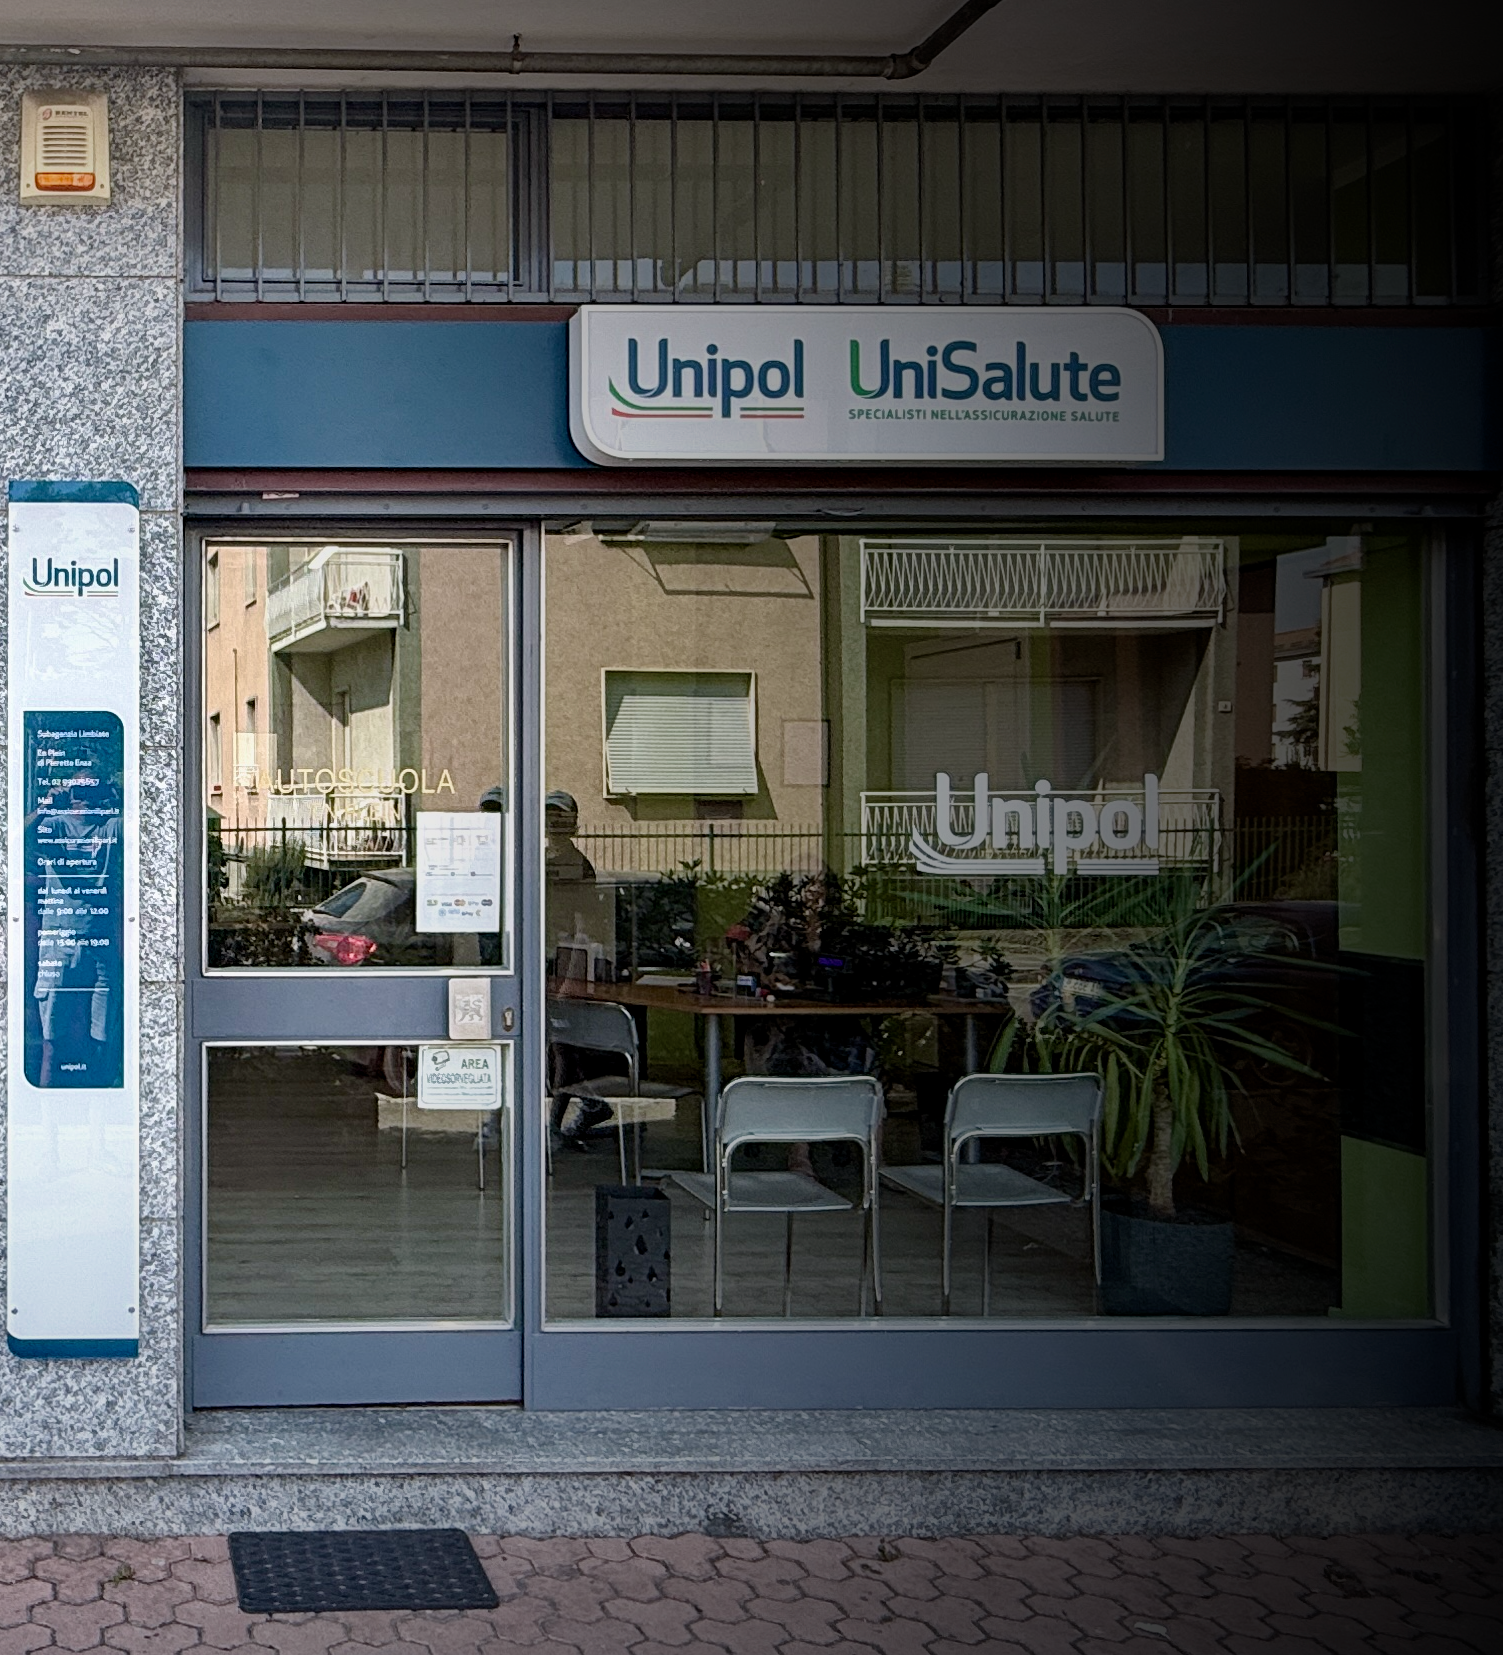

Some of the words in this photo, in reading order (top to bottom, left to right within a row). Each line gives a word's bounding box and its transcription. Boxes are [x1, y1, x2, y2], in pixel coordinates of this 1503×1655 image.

[627, 338, 804, 418] Unipol
[849, 339, 1122, 402] UniSalute
[848, 408, 927, 420] SPECIALISTI
[931, 409, 1067, 421] NELL'ASSICURAZIONE
[1071, 411, 1121, 422] SALUTE
[32, 557, 119, 597] Unipol
[256, 768, 457, 795] AUTOSCUOLA
[936, 772, 1160, 876] Unipol
[461, 1058, 489, 1070] AREA
